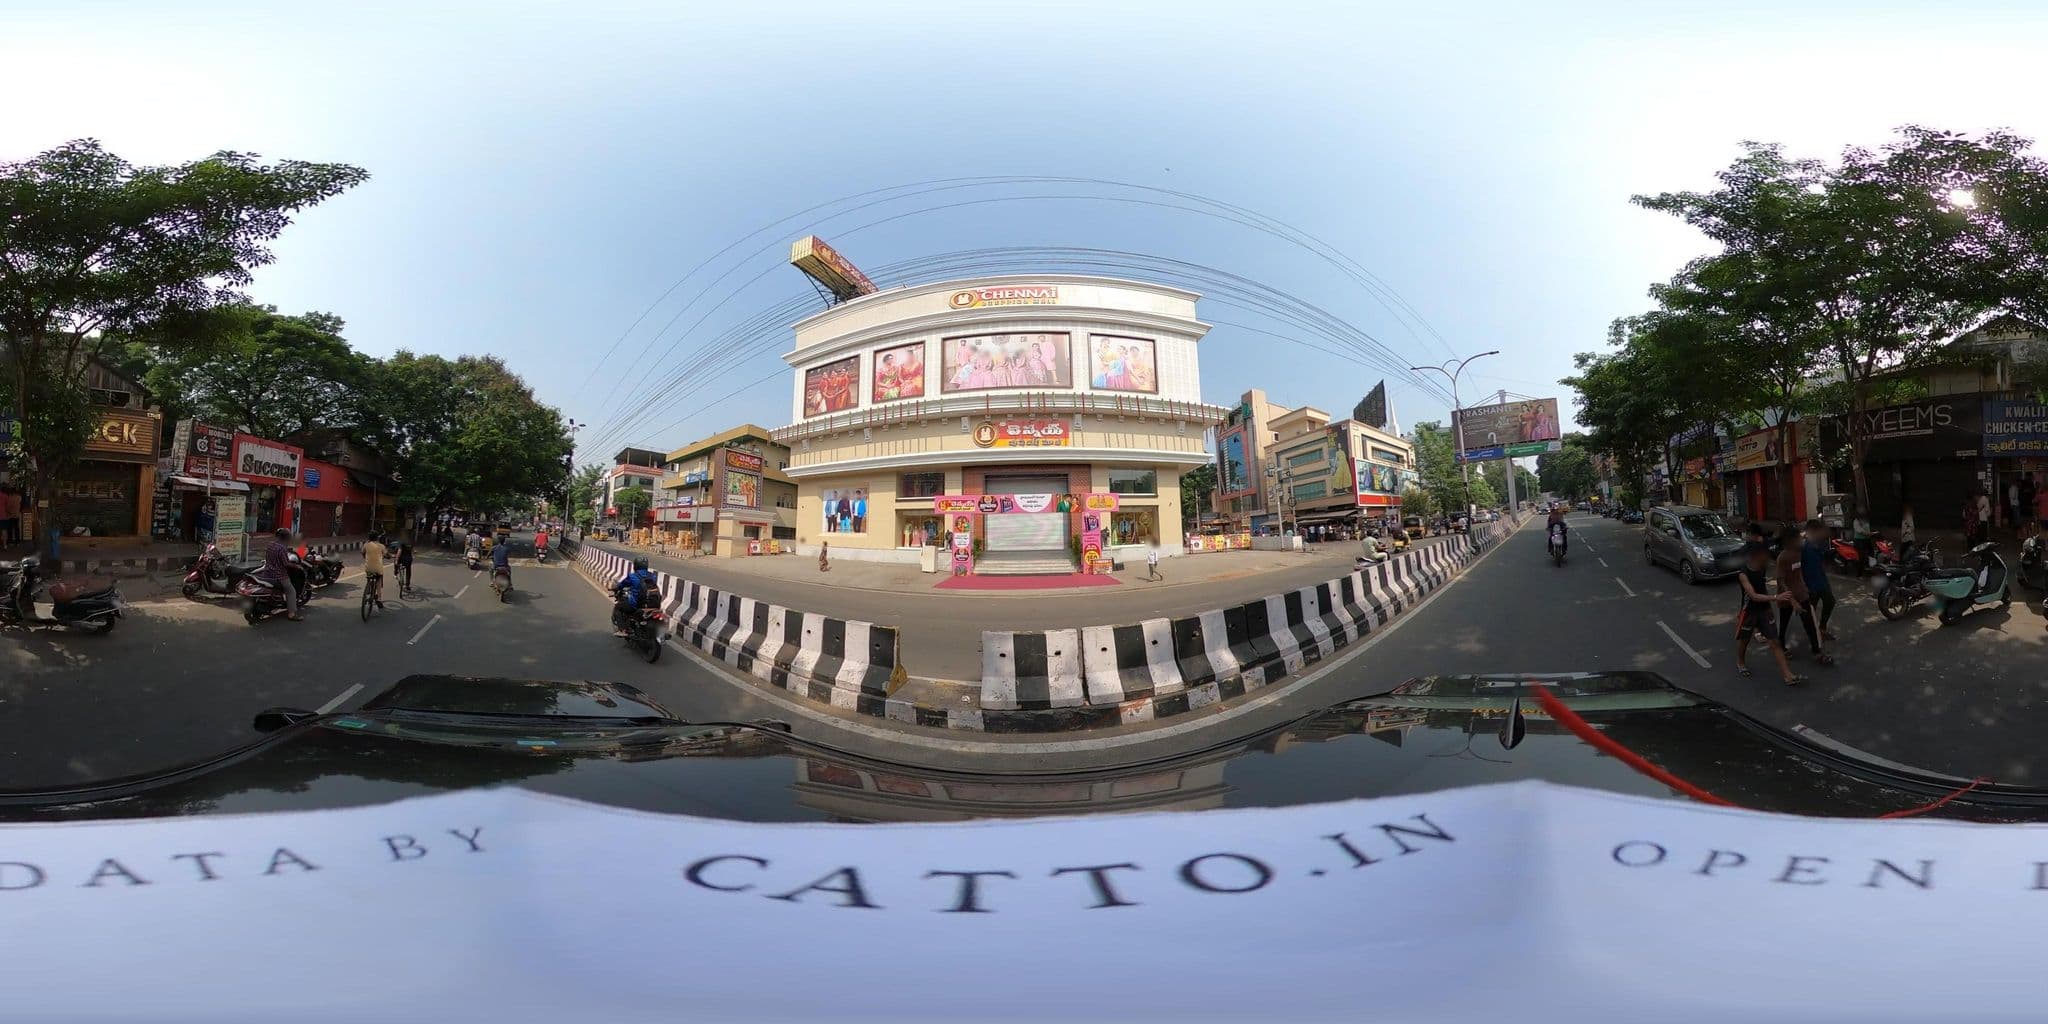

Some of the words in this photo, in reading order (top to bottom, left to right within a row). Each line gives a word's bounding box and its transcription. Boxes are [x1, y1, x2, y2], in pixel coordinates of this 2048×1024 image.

[1985, 421, 2032, 434] CHICKEN
[380, 827, 485, 861] BY
[684, 813, 1457, 913] CATTO.IN
[1611, 840, 1936, 889] OPEN
